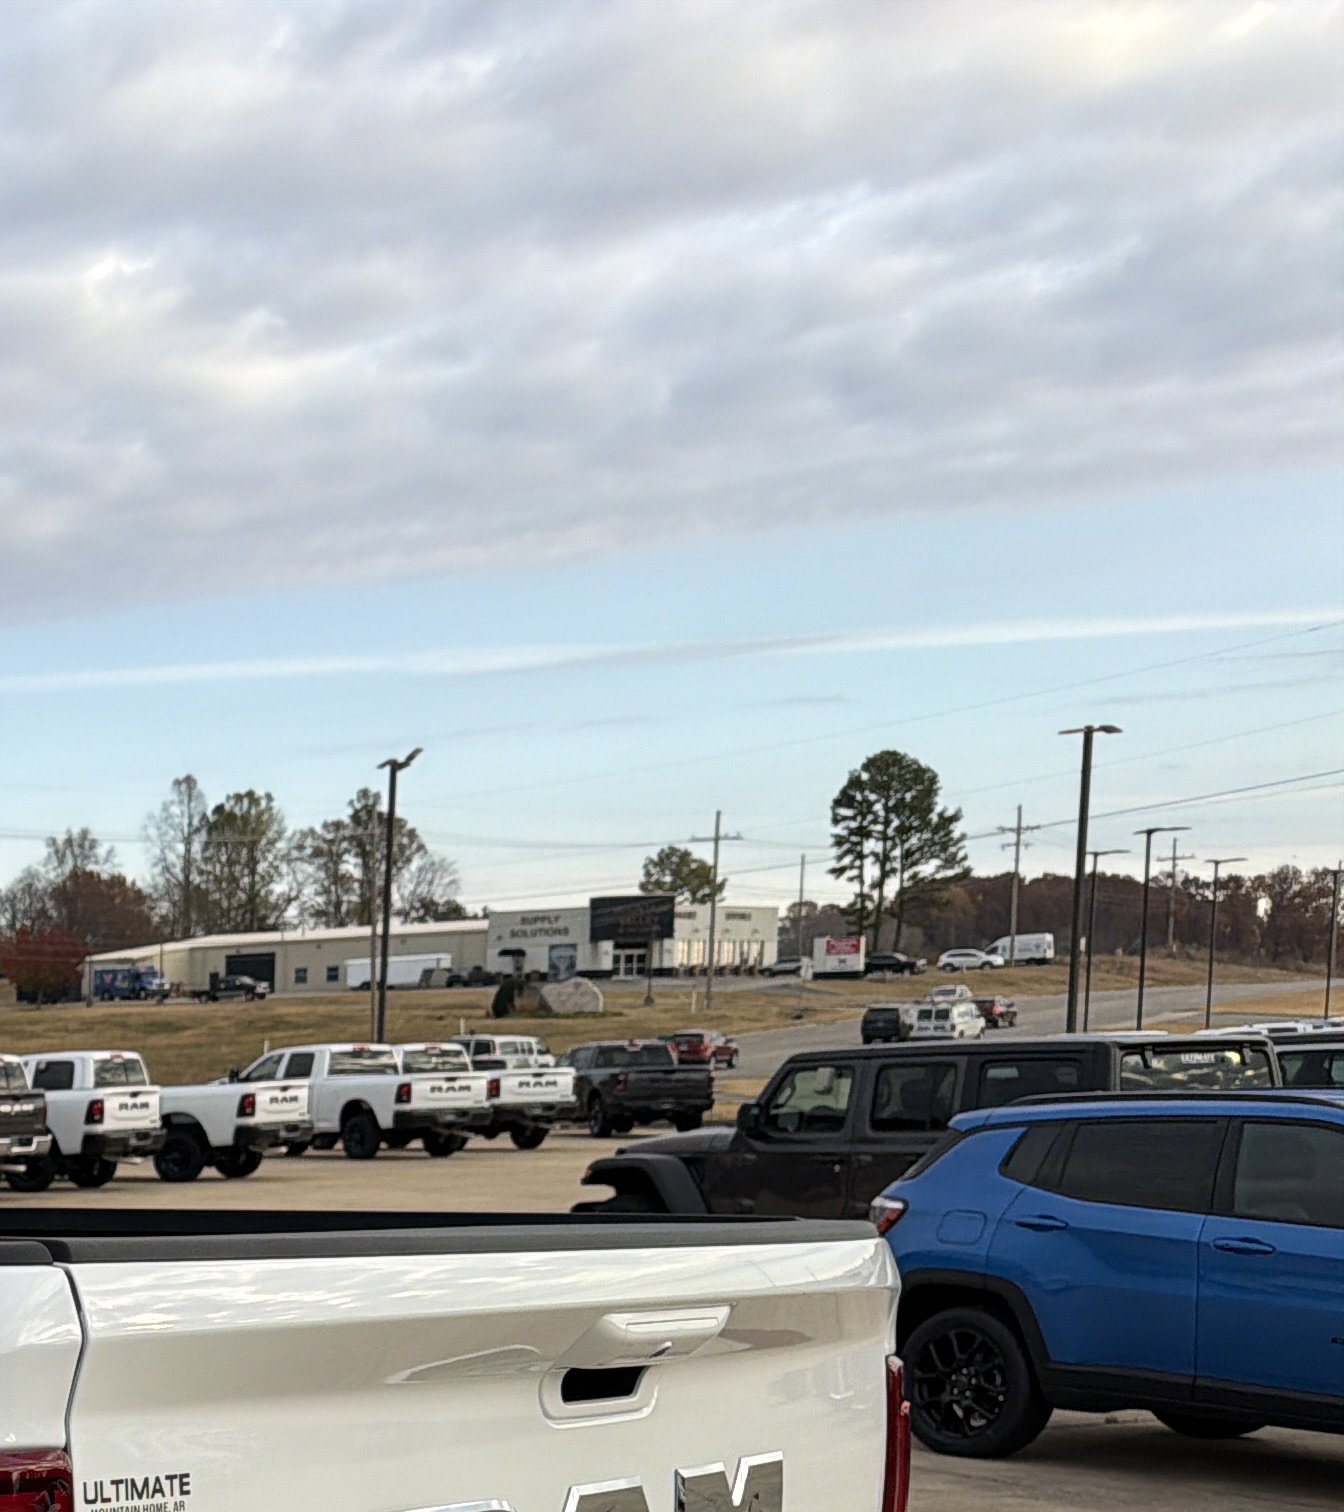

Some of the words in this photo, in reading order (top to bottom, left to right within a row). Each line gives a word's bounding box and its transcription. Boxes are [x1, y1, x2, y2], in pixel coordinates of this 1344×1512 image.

[520, 915, 561, 926] SUPPLY
[509, 927, 569, 939] SOLUTIONS
[517, 1079, 558, 1088] RAM
[429, 1085, 472, 1094] RAM
[268, 1095, 299, 1105] RAM
[118, 1101, 150, 1111] RAM
[82, 1473, 191, 1505] ULTIMATE
[173, 1500, 185, 1512] AR
